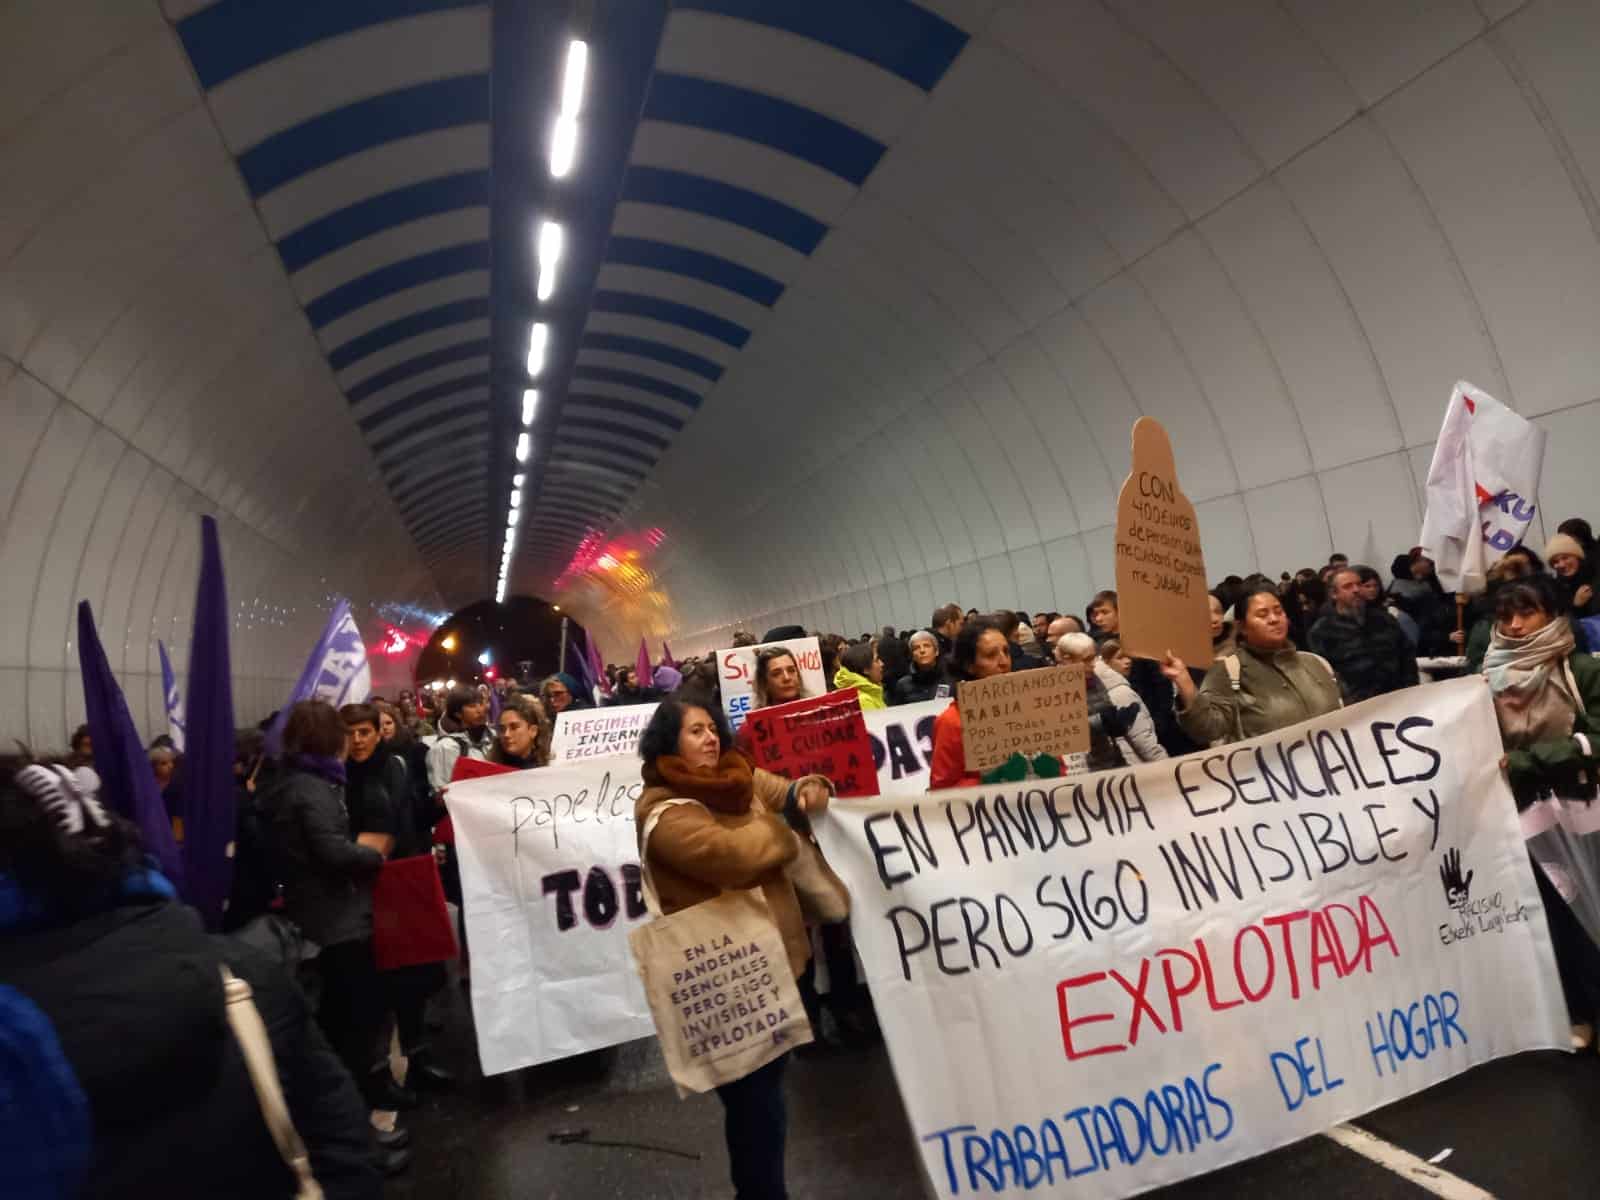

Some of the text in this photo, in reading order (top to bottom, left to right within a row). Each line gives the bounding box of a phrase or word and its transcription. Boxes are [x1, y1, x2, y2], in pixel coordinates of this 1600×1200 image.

[1139, 471, 1175, 504] CON
[965, 690, 1083, 720] RABIA JUSTA
[566, 741, 640, 760] EXCLAVIT
[577, 729, 642, 746] INTERN
[967, 726, 996, 741] POR
[973, 725, 1081, 755] CUIDADORAS
[864, 716, 1441, 890] EN PANDEMIA ESENCIALES
[886, 789, 1440, 981] PERO SIGO INVISIBLE Y
[673, 942, 760, 984] PANDEMIA
[685, 934, 733, 961] EN LA
[671, 956, 769, 1005] ESENCIALES
[683, 973, 772, 1019] PERO SIGO
[1056, 894, 1400, 1061] EXPLOTADA
[682, 994, 767, 1040] INVISIBLE
[770, 985, 780, 1001] Y
[690, 1007, 789, 1057] EXPLOTADA
[924, 990, 1468, 1196] TRABAJADORAS DEL HOGAR
